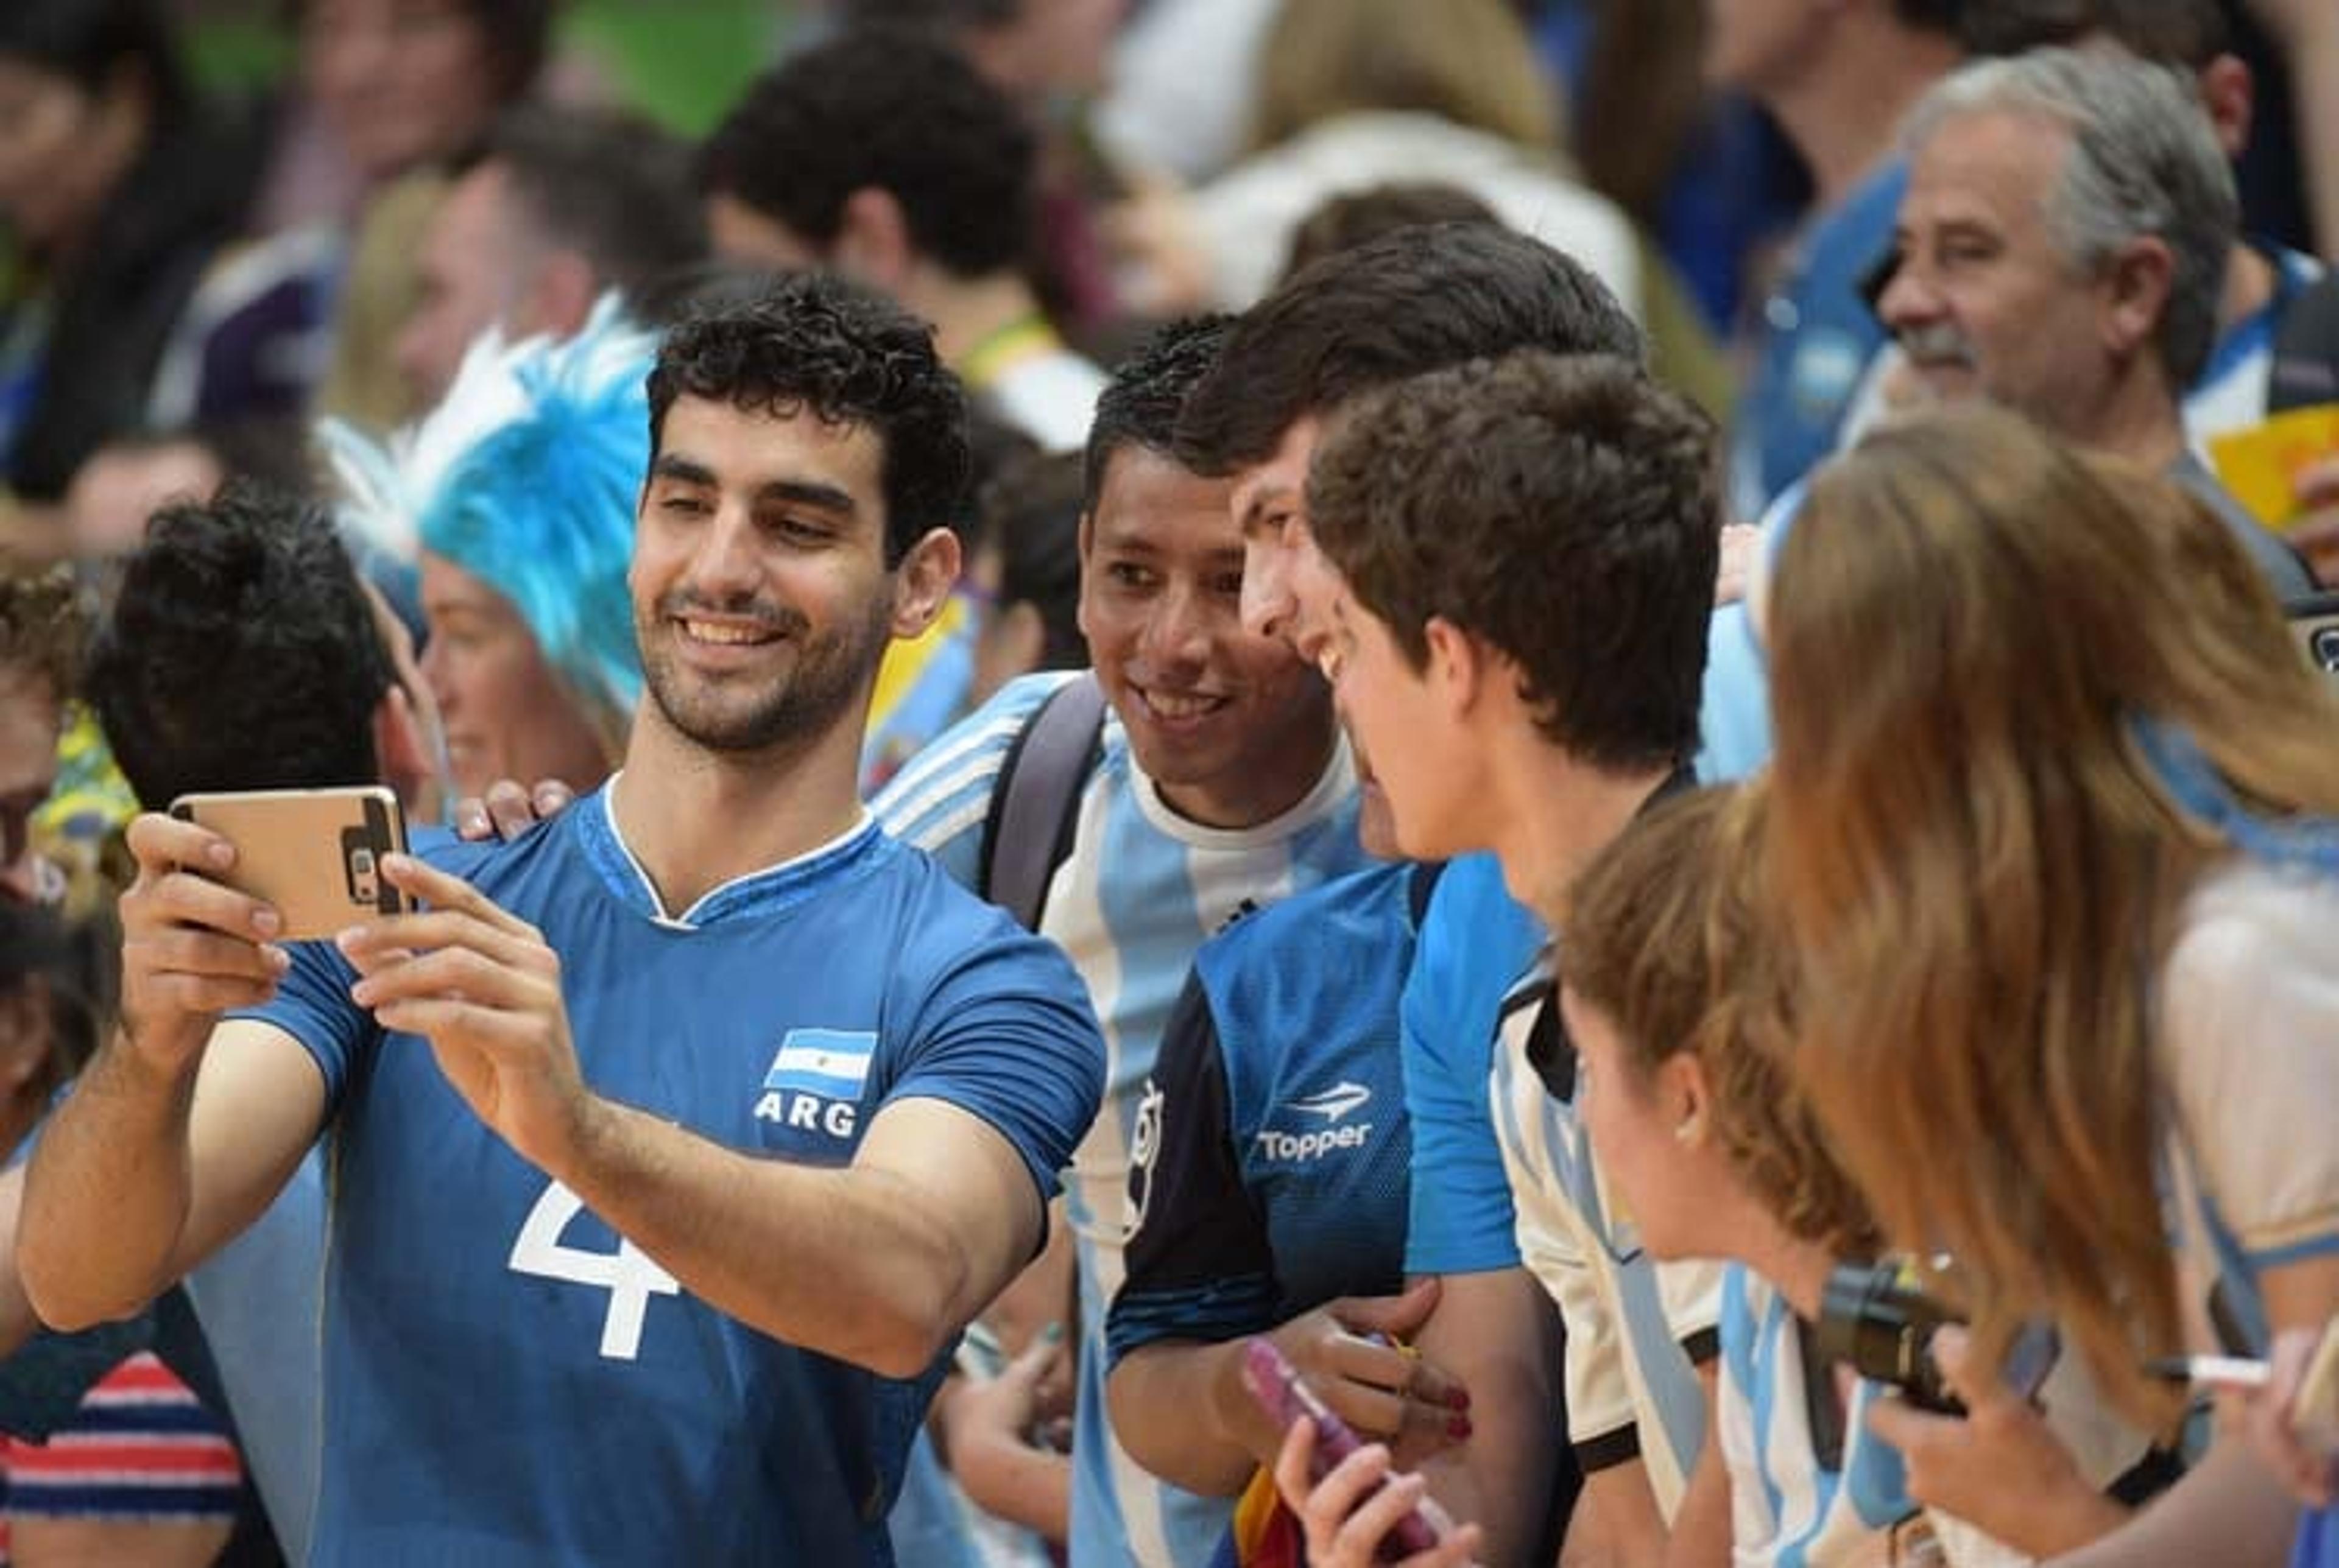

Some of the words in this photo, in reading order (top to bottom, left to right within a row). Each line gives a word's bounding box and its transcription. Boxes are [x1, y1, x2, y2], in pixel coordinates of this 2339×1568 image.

[754, 1091, 855, 1139] ARG
[1257, 1124, 1372, 1162] Topper
[509, 1178, 680, 1360] 4
